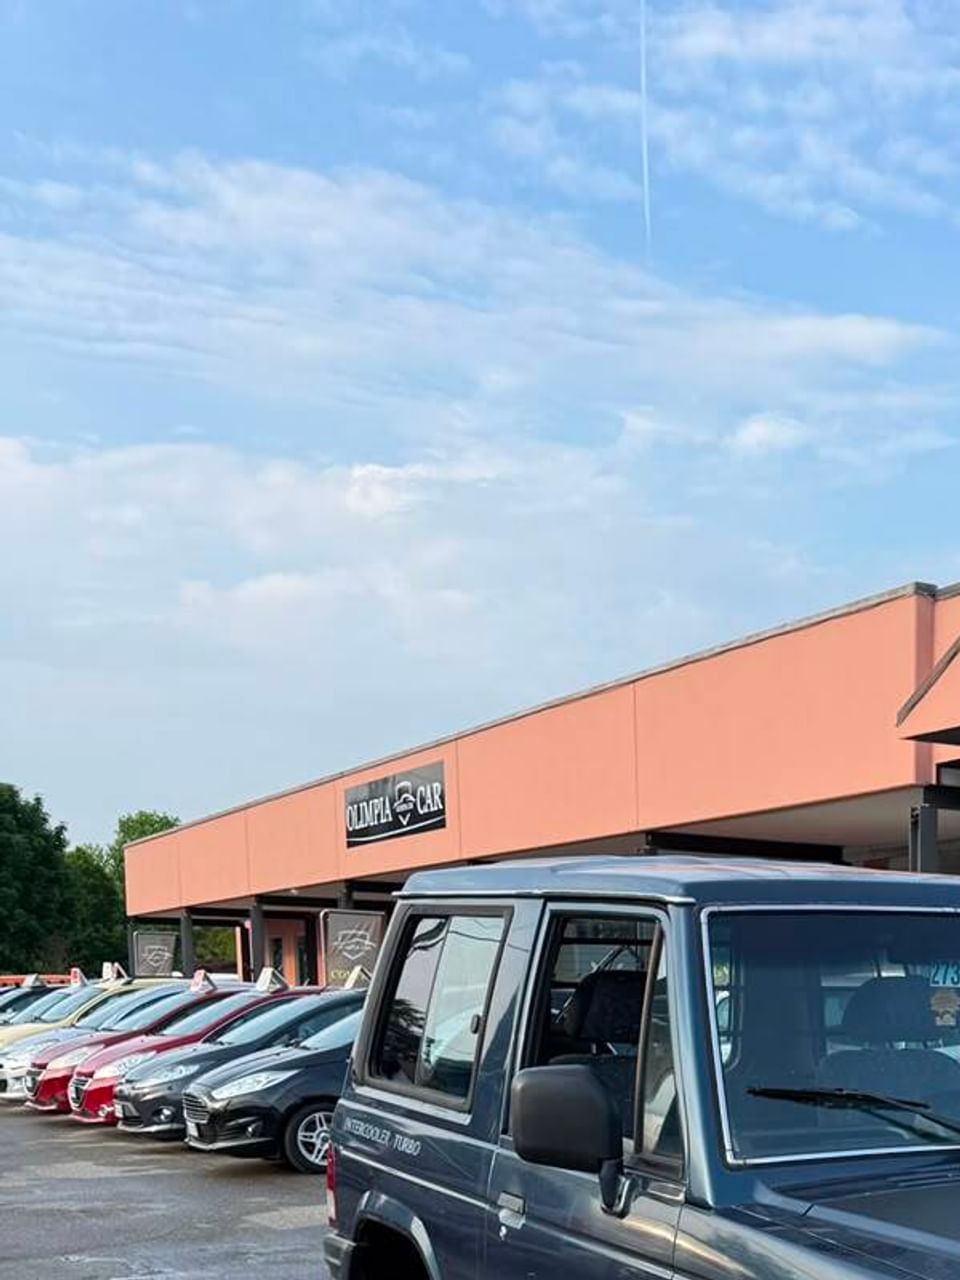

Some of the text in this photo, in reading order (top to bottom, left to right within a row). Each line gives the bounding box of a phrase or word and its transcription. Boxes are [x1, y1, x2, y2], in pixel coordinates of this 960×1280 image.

[346, 782, 443, 831] OLIMPIA CAR
[931, 960, 960, 985] 273
[344, 1117, 421, 1156] INTERCOOLER TURBO
